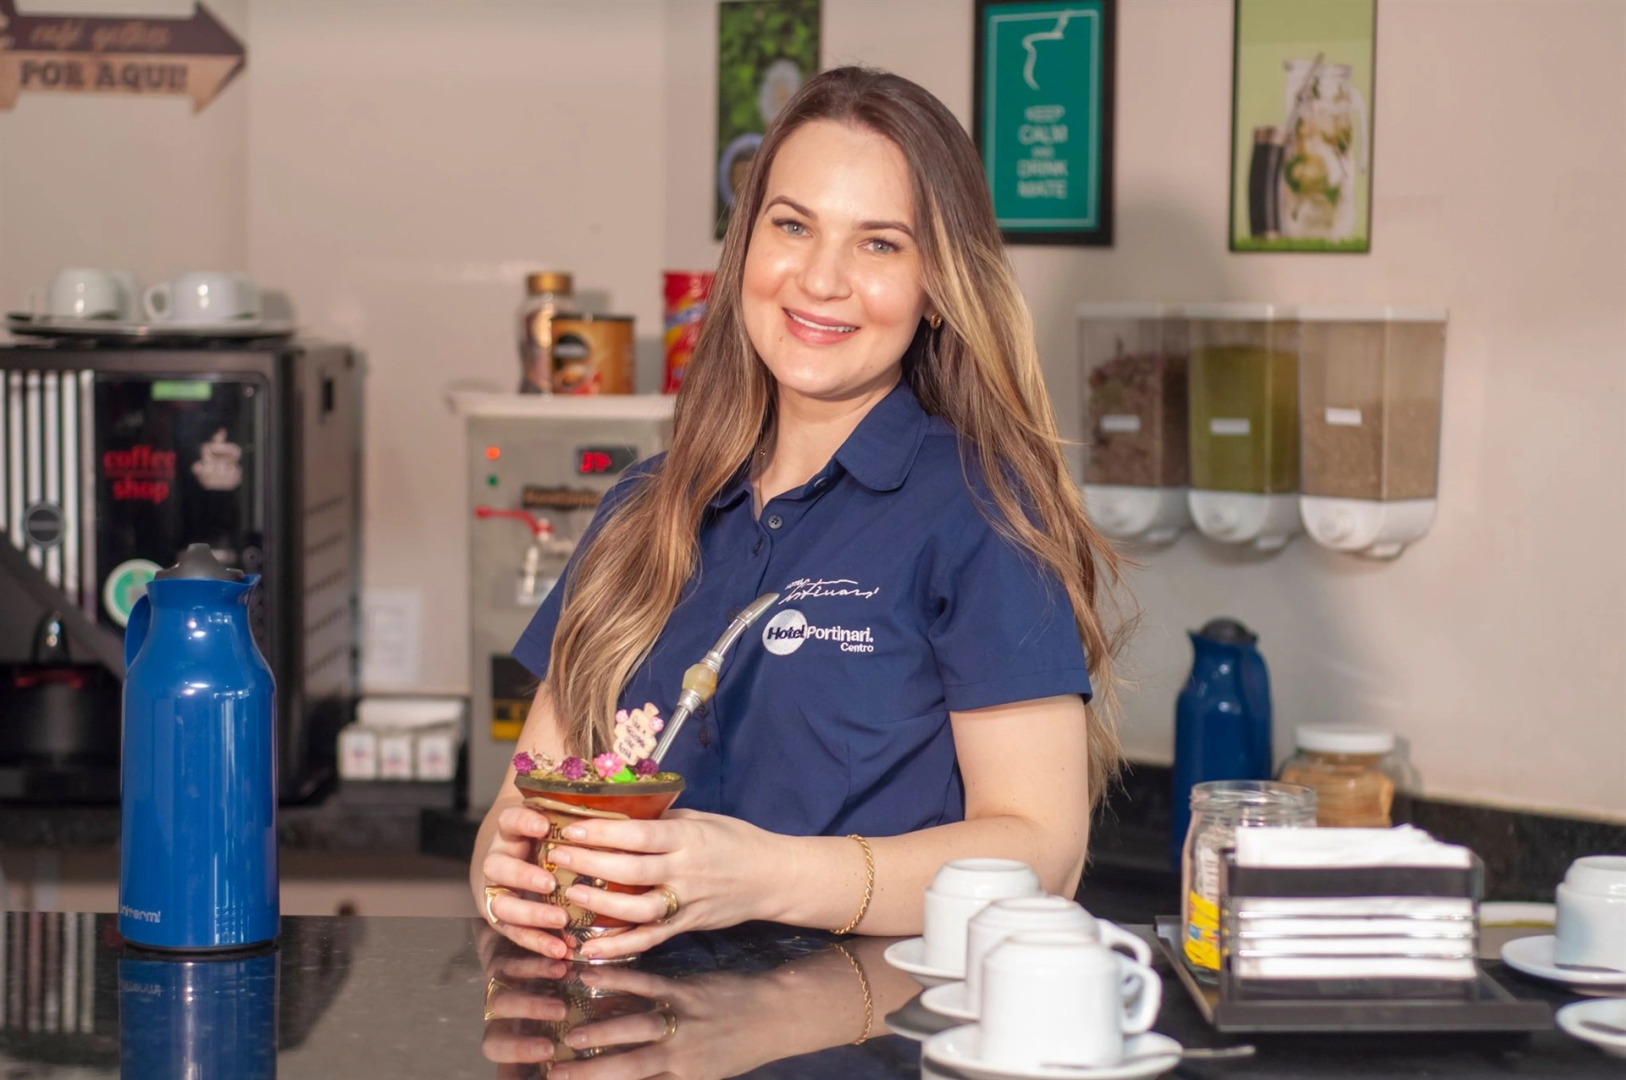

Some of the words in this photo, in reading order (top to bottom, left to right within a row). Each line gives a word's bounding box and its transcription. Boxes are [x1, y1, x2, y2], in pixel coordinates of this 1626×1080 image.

[20, 60, 84, 88] POR
[1017, 123, 1069, 145] CALM
[1016, 159, 1069, 178] DRINK
[1017, 179, 1068, 199] MATE
[103, 444, 176, 468] coffee
[113, 476, 169, 505] shop
[766, 624, 806, 641] Hotel
[840, 642, 875, 653] Centro
